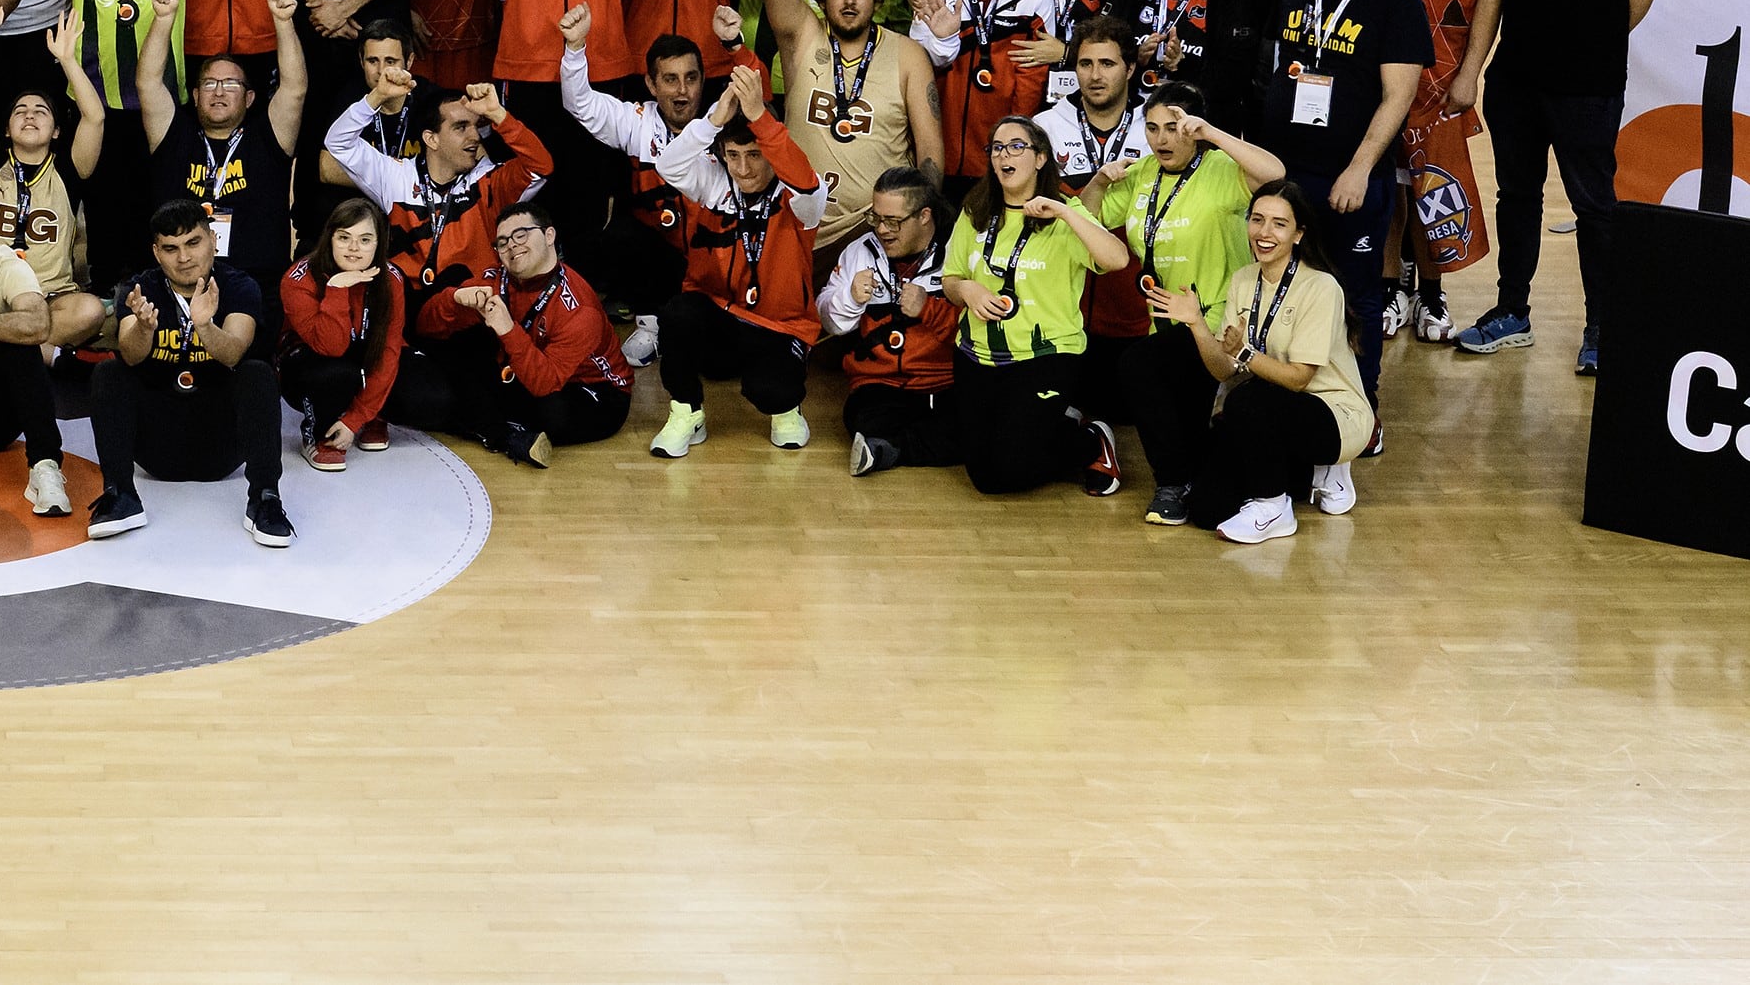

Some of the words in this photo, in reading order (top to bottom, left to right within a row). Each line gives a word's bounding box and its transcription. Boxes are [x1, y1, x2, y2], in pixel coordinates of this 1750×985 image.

[1288, 9, 1363, 44] UAM
[1058, 77, 1075, 87] TEC
[806, 87, 874, 136] BG
[190, 158, 244, 182] UM
[1427, 221, 1460, 242] RESA
[152, 348, 215, 363] UNIVESIDA
